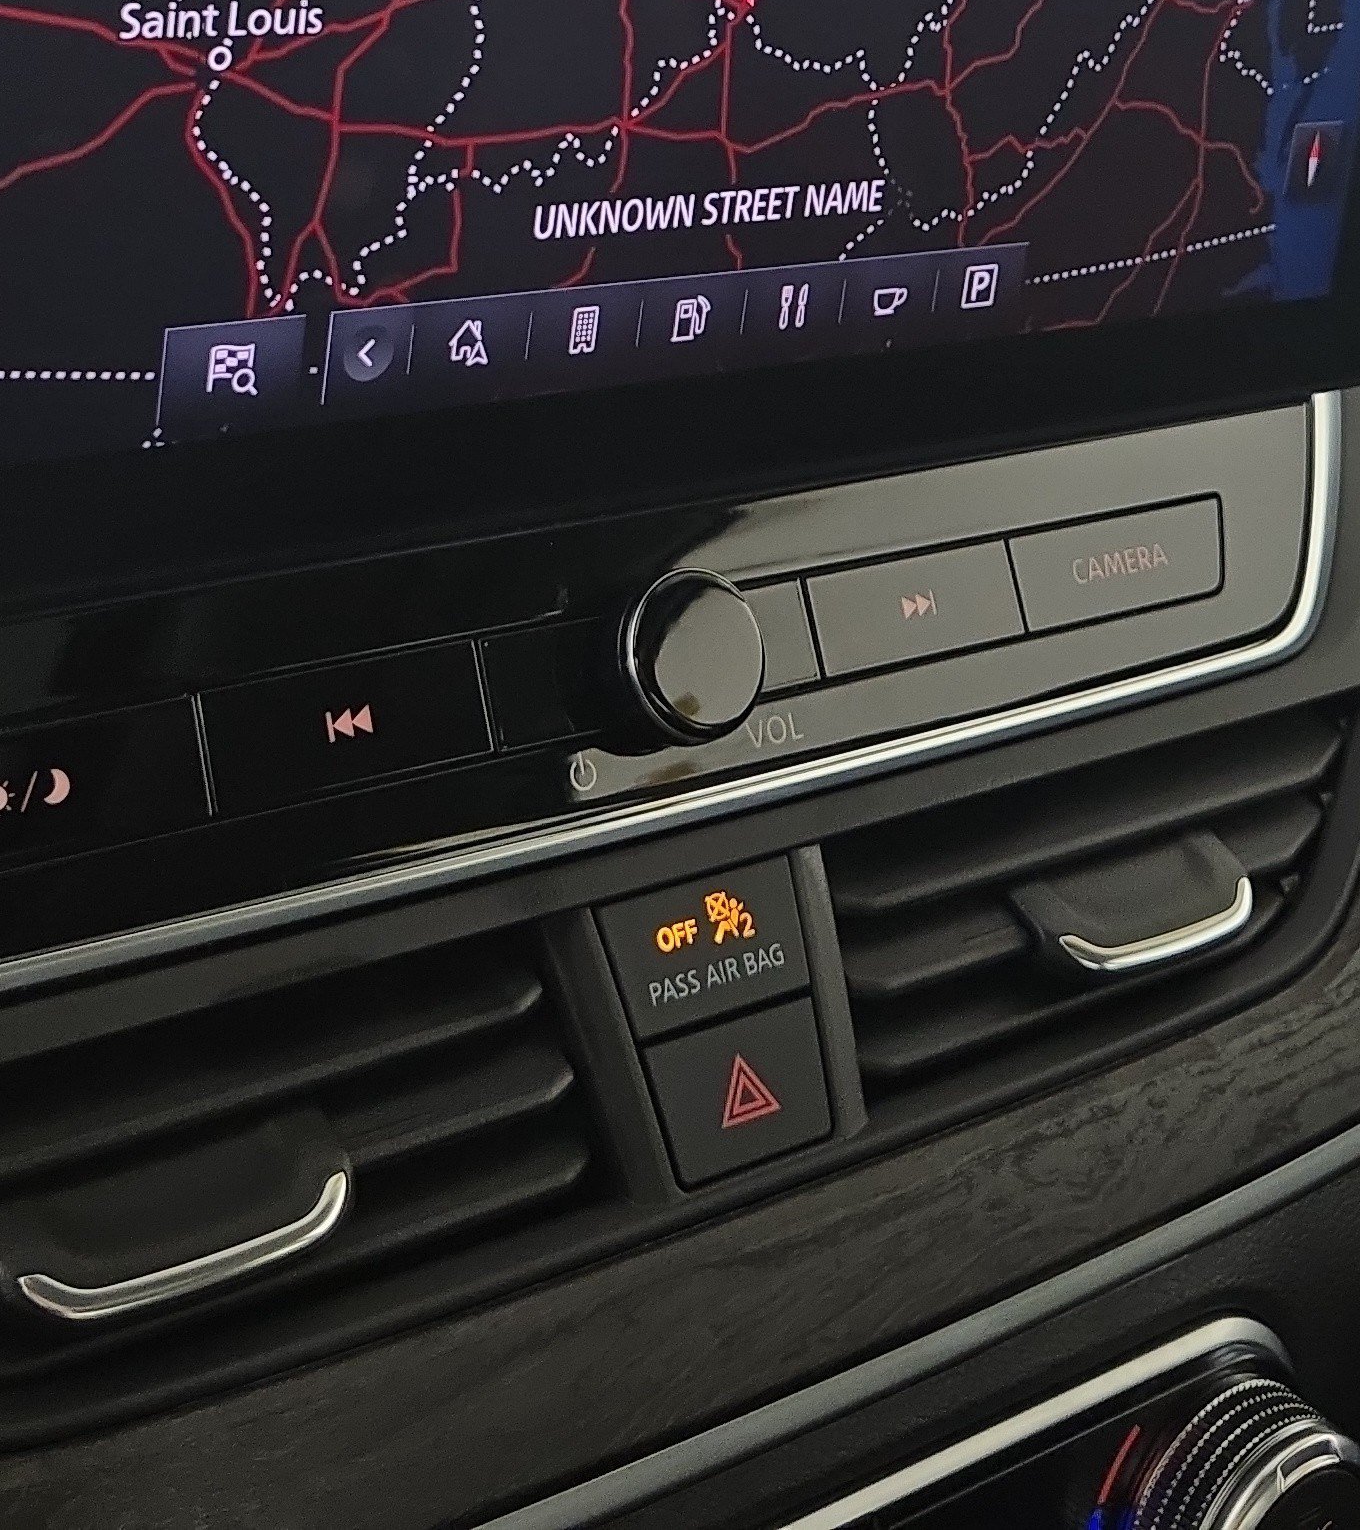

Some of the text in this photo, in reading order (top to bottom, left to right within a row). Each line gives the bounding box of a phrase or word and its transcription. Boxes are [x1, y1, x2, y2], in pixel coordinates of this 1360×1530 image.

[119, 0, 323, 40] Saint Louis
[533, 179, 886, 240] UNKNOWN STREET NAME
[1072, 543, 1169, 585] CAMERA
[745, 712, 805, 748] VOL
[656, 918, 698, 953] OFF
[648, 942, 786, 1007] PASS AIR BAG
